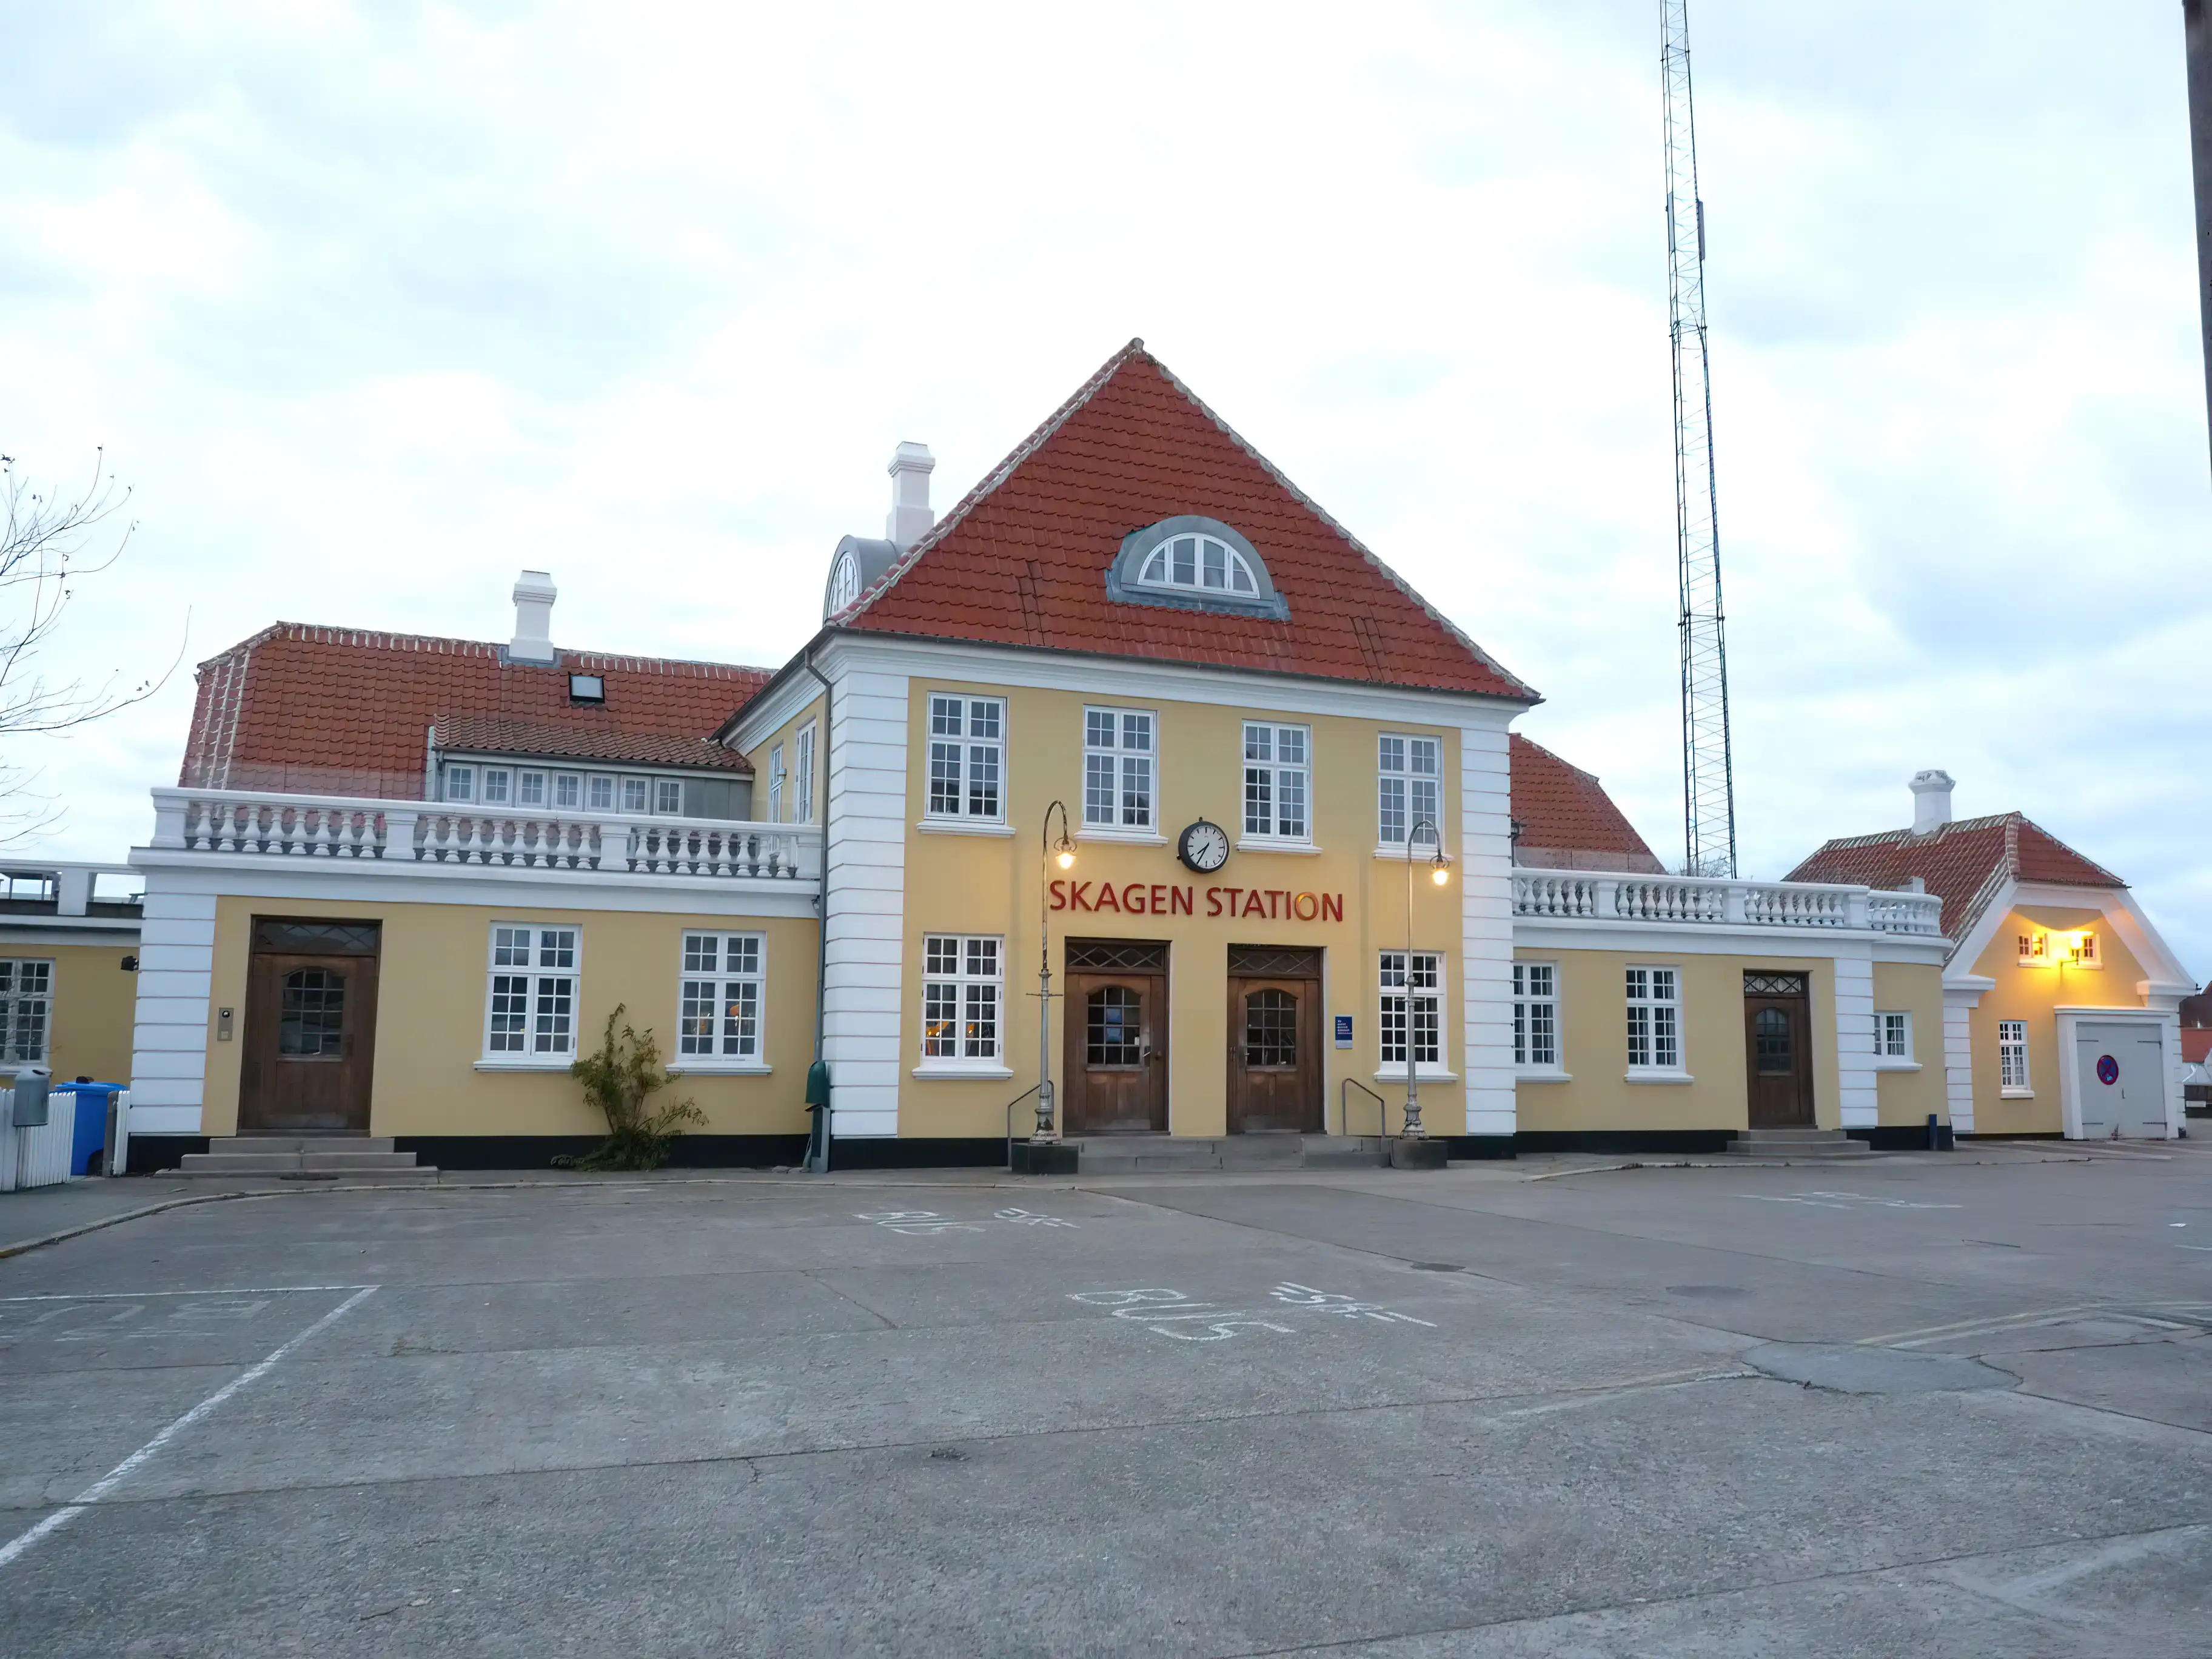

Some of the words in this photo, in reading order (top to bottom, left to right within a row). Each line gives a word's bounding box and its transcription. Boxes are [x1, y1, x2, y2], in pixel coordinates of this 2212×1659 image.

[1050, 880, 1193, 916] SKAGEN
[1207, 887, 1343, 922] STATION
[851, 1211, 987, 1235] BUS
[1065, 1289, 1297, 1341] BUS
